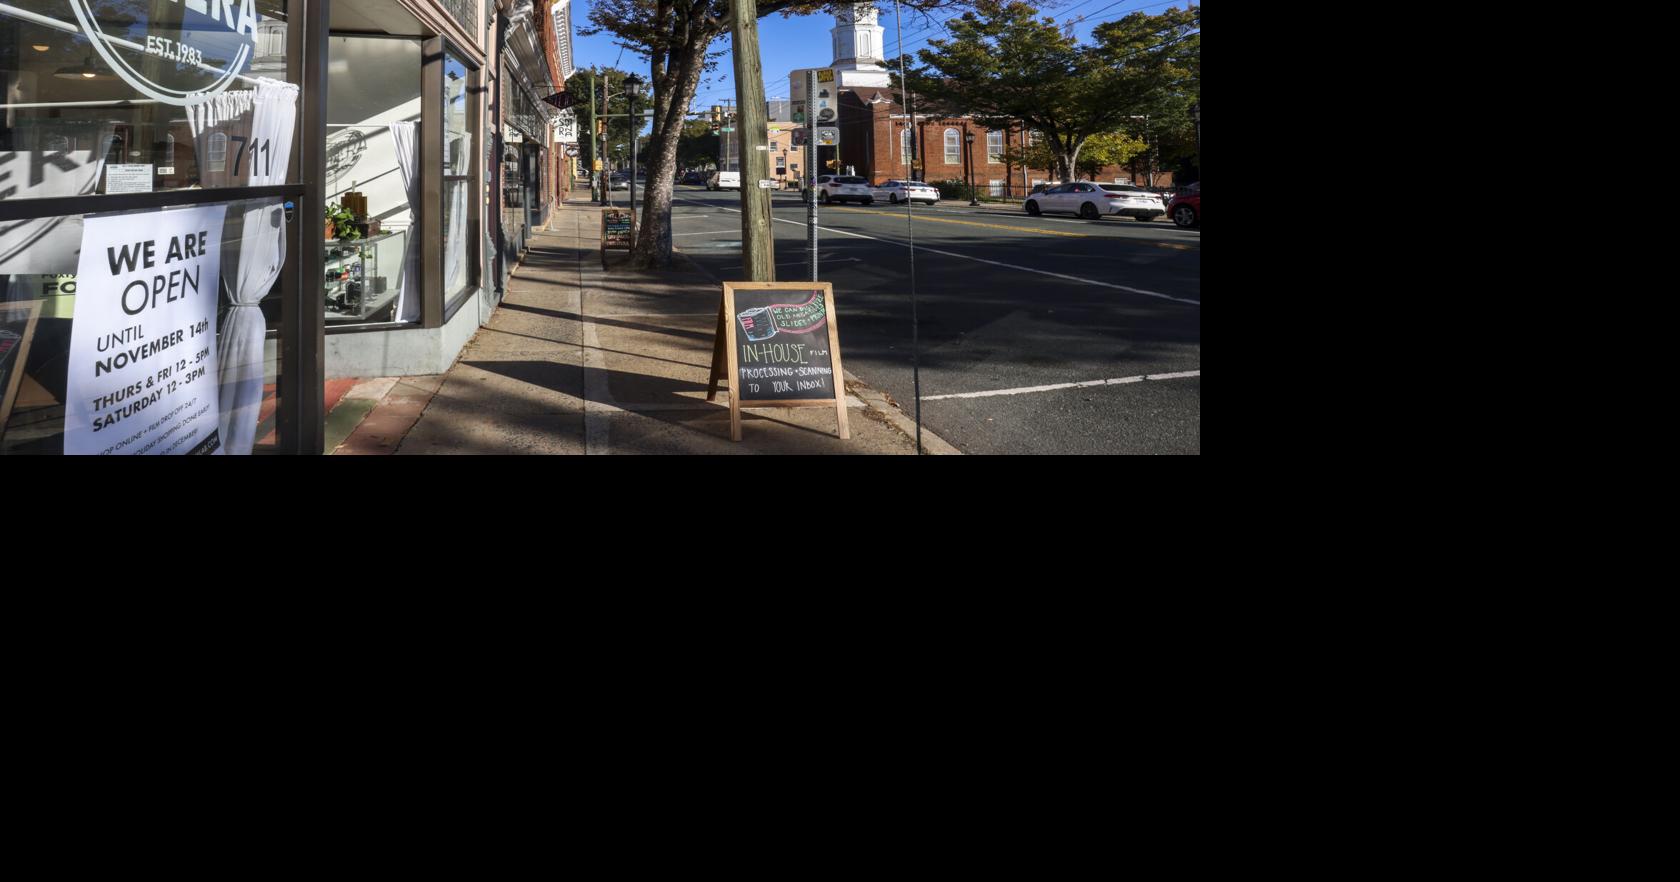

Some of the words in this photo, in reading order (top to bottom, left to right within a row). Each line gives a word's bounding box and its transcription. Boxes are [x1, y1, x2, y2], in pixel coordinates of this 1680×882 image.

[230, 135, 270, 176] 711
[107, 240, 155, 276] WE
[165, 231, 208, 264] ARE
[121, 265, 200, 316] OPEN
[95, 329, 184, 378] NOVEMBER
[189, 317, 209, 338] 14th
[97, 324, 144, 353] UNTIL
[742, 343, 808, 364] IN-HOUSE
[92, 380, 142, 412] THURS
[145, 376, 154, 389] &
[157, 365, 172, 382] FRI
[175, 359, 187, 373] 12
[195, 346, 210, 364] 5PM
[741, 367, 794, 379] PROCESSING
[799, 367, 832, 377] SCANNING
[749, 383, 760, 393] TO
[772, 380, 793, 393] YOUR
[797, 377, 825, 391] INBOX!
[93, 388, 162, 432] SATURDAY
[166, 380, 177, 395] 12
[185, 365, 206, 384] 3PM
